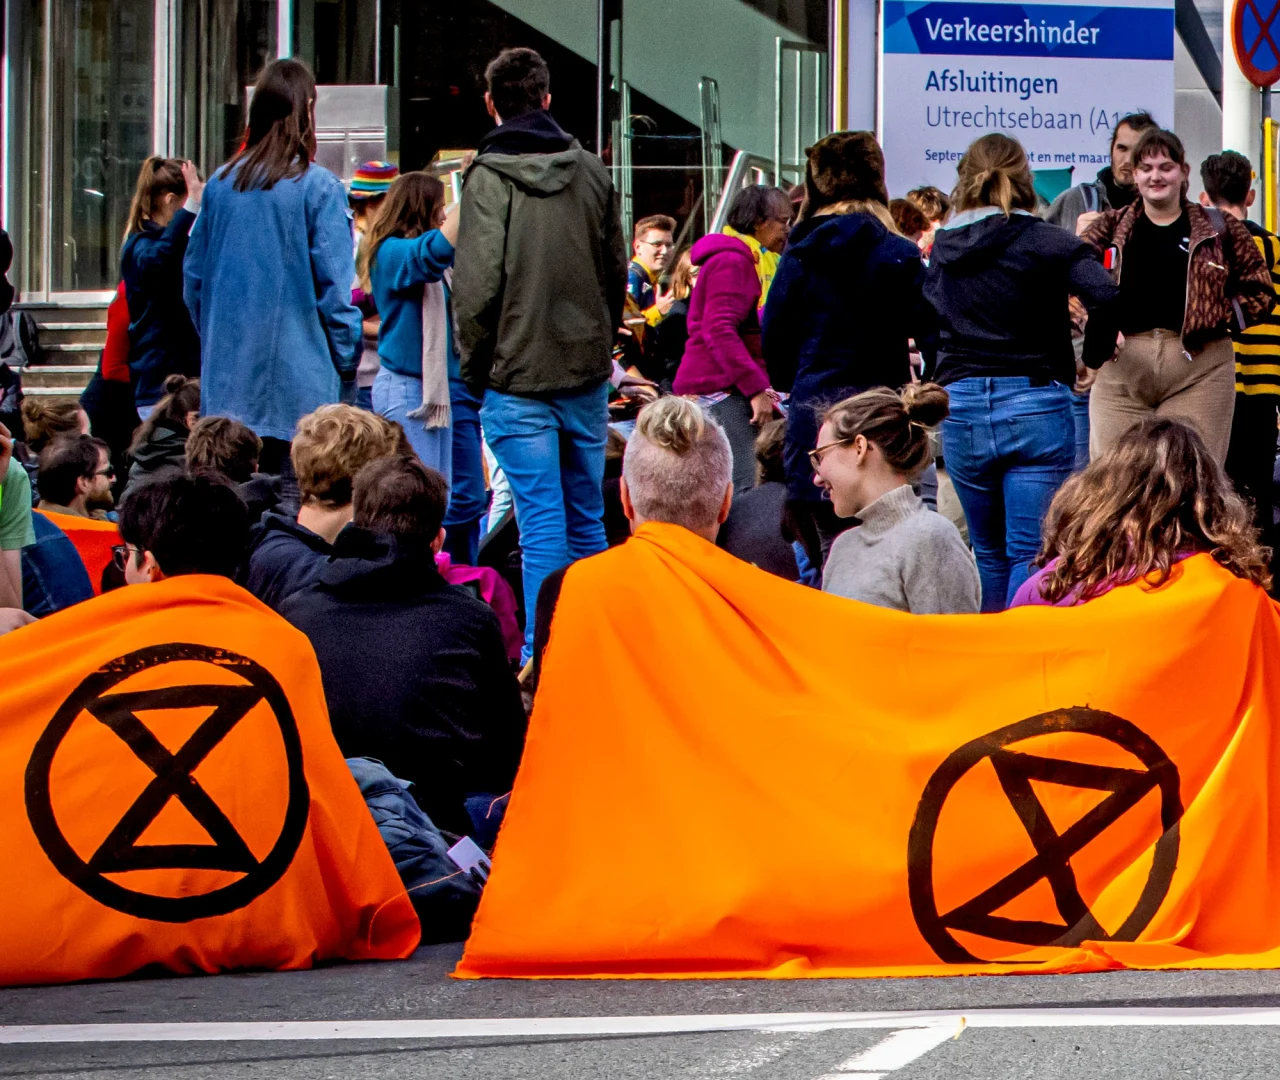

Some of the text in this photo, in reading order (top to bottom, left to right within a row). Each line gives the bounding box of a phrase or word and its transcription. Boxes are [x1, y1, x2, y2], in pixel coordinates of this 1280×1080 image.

[925, 17, 1100, 45] Verkeershinder
[925, 69, 1059, 100] Afsluitingen
[926, 105, 1139, 135] Utrechtsebaan (A1
[1037, 154, 1051, 162] en
[1055, 152, 1075, 163] met
